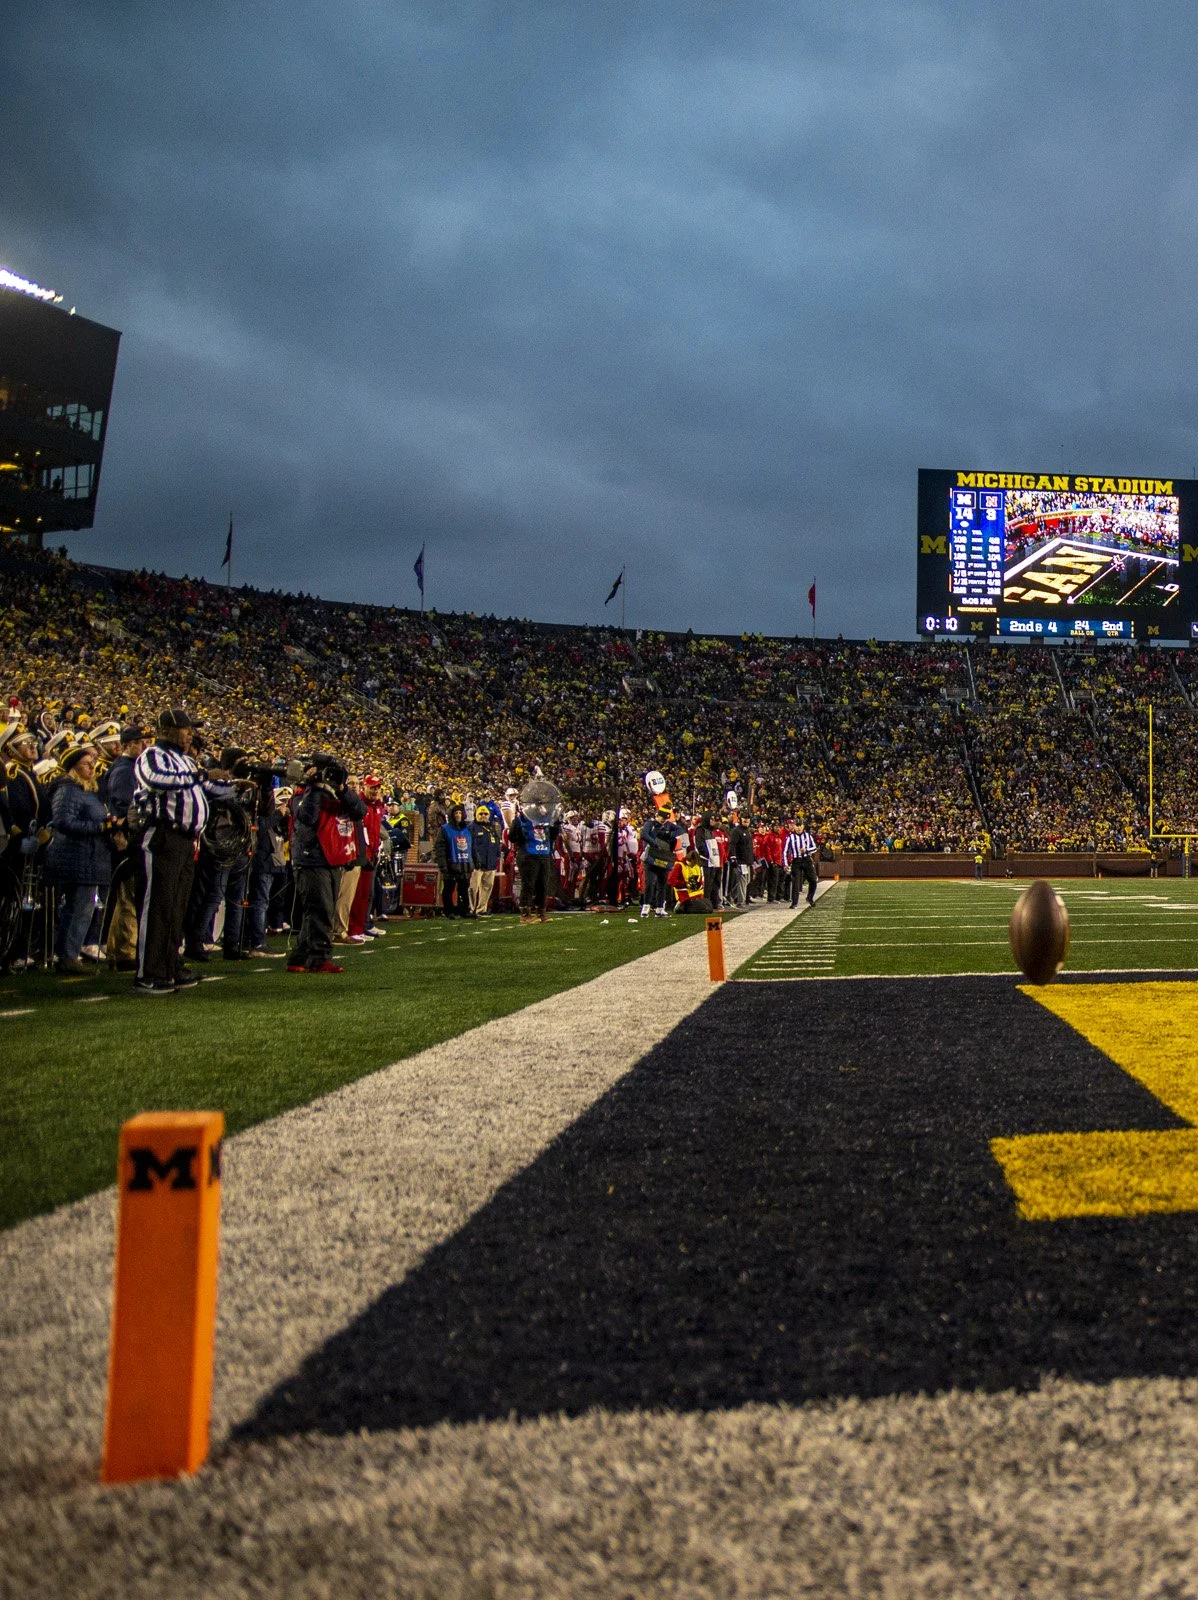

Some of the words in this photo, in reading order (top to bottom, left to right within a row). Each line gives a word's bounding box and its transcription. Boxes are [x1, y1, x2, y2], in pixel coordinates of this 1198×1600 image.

[957, 471, 1069, 490] MICHIGAN
[1074, 478, 1174, 495] STADIUM
[957, 493, 972, 505] M
[985, 496, 998, 507] N
[956, 508, 973, 520] 14
[921, 535, 947, 554] M
[970, 620, 984, 632] M
[1009, 619, 1035, 633] 2nd
[1047, 621, 1058, 634] 4
[1075, 619, 1089, 631] 24
[1102, 620, 1124, 632] 2nd
[1148, 624, 1161, 635] M
[1106, 630, 1120, 638] QTR
[708, 922, 720, 931] M
[128, 1147, 198, 1191] M
